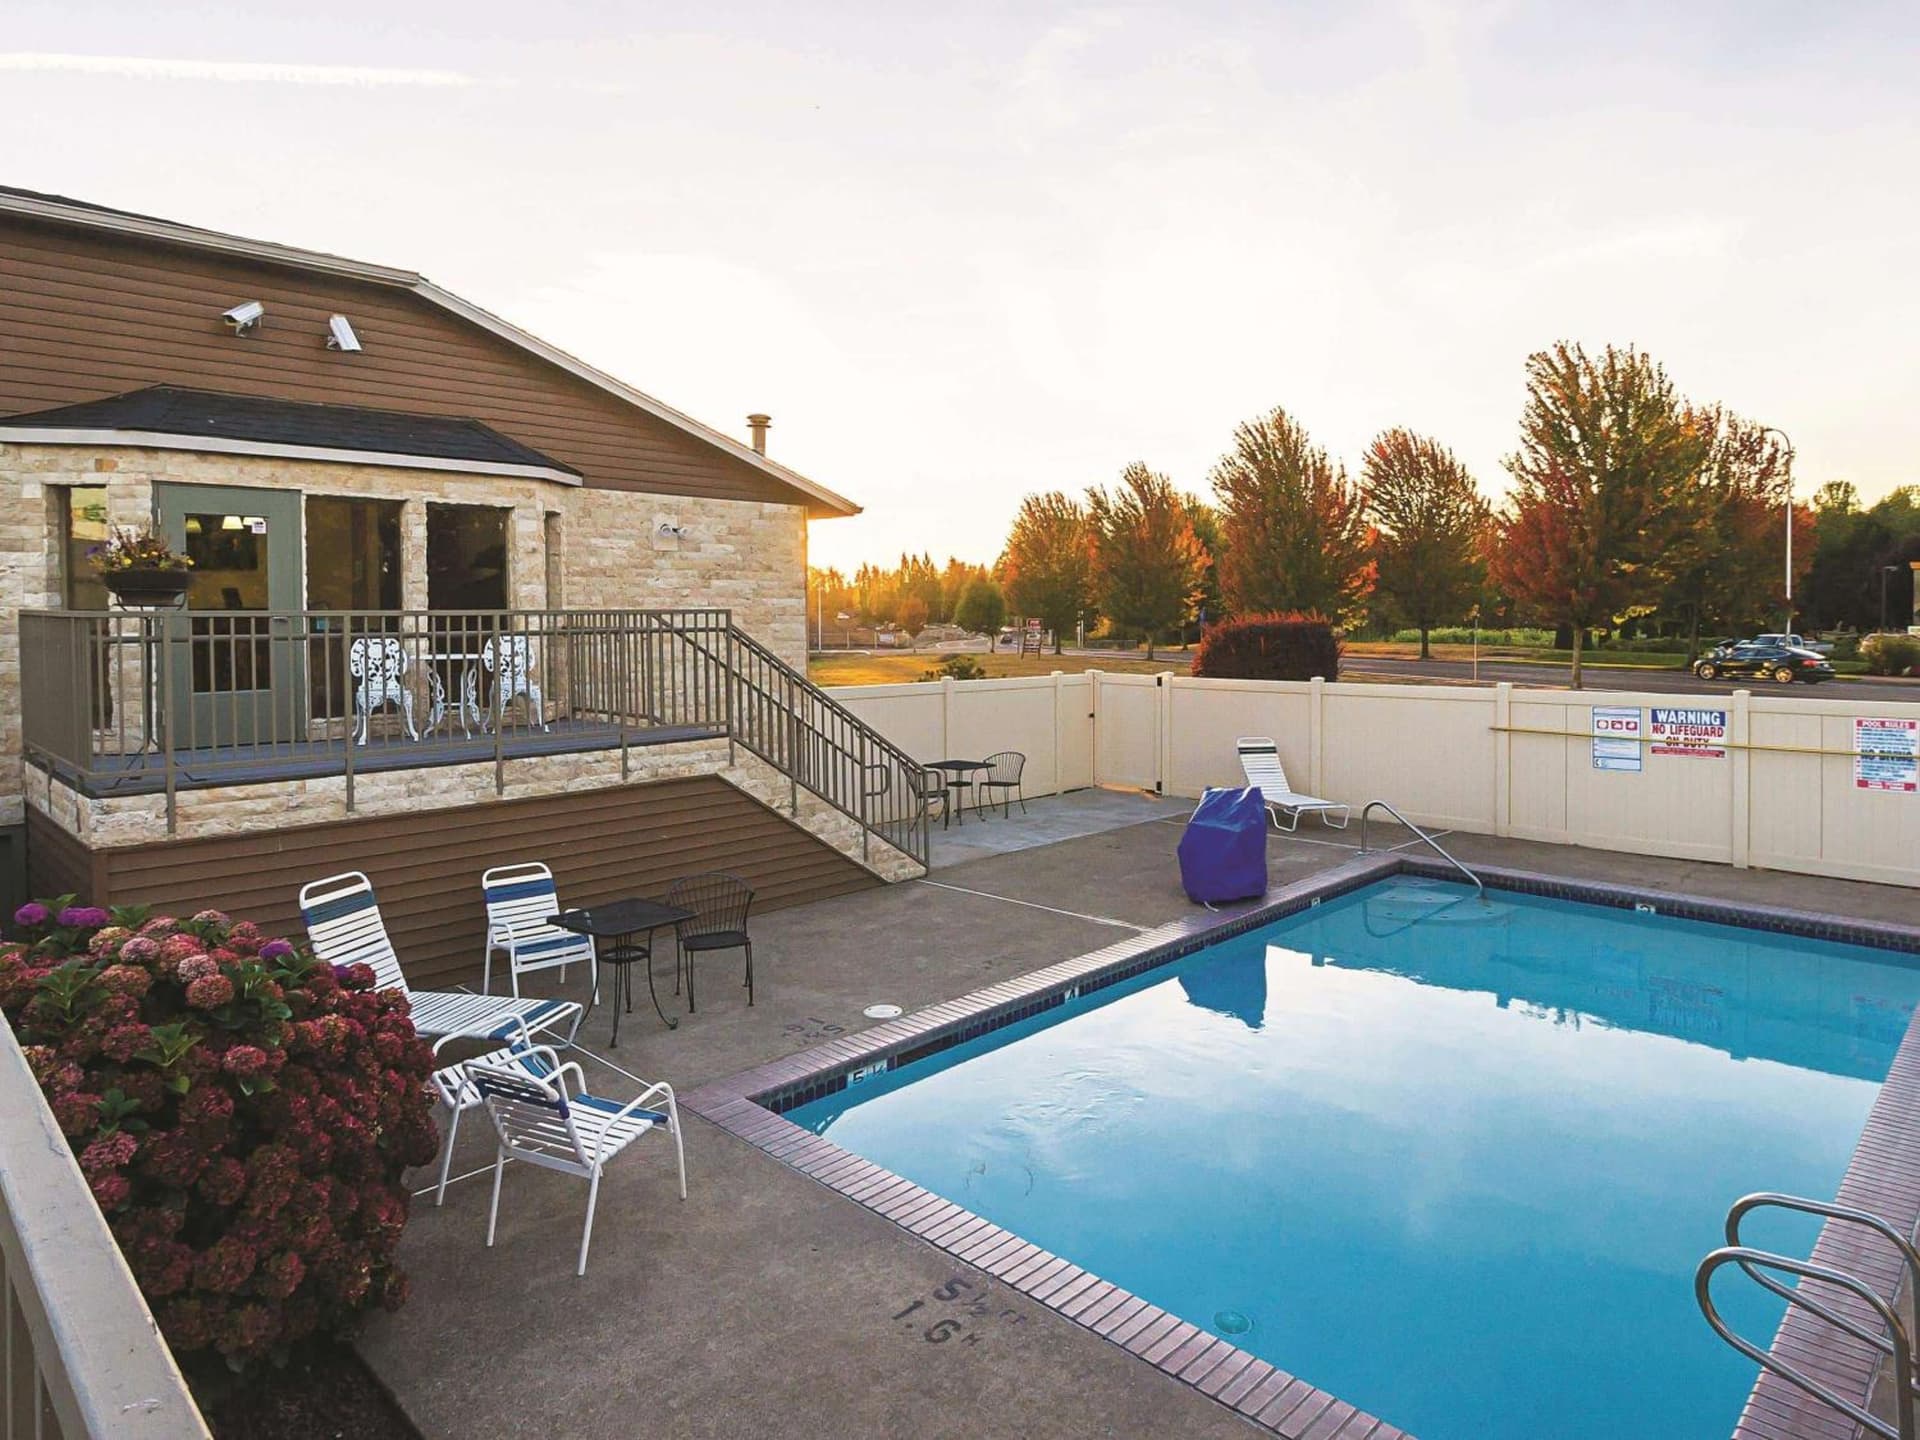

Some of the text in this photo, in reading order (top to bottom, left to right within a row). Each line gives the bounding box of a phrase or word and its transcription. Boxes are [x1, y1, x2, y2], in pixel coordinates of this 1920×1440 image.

[1656, 710, 1721, 725] WARNING
[1652, 725, 1724, 738] NO LIFEGUARD
